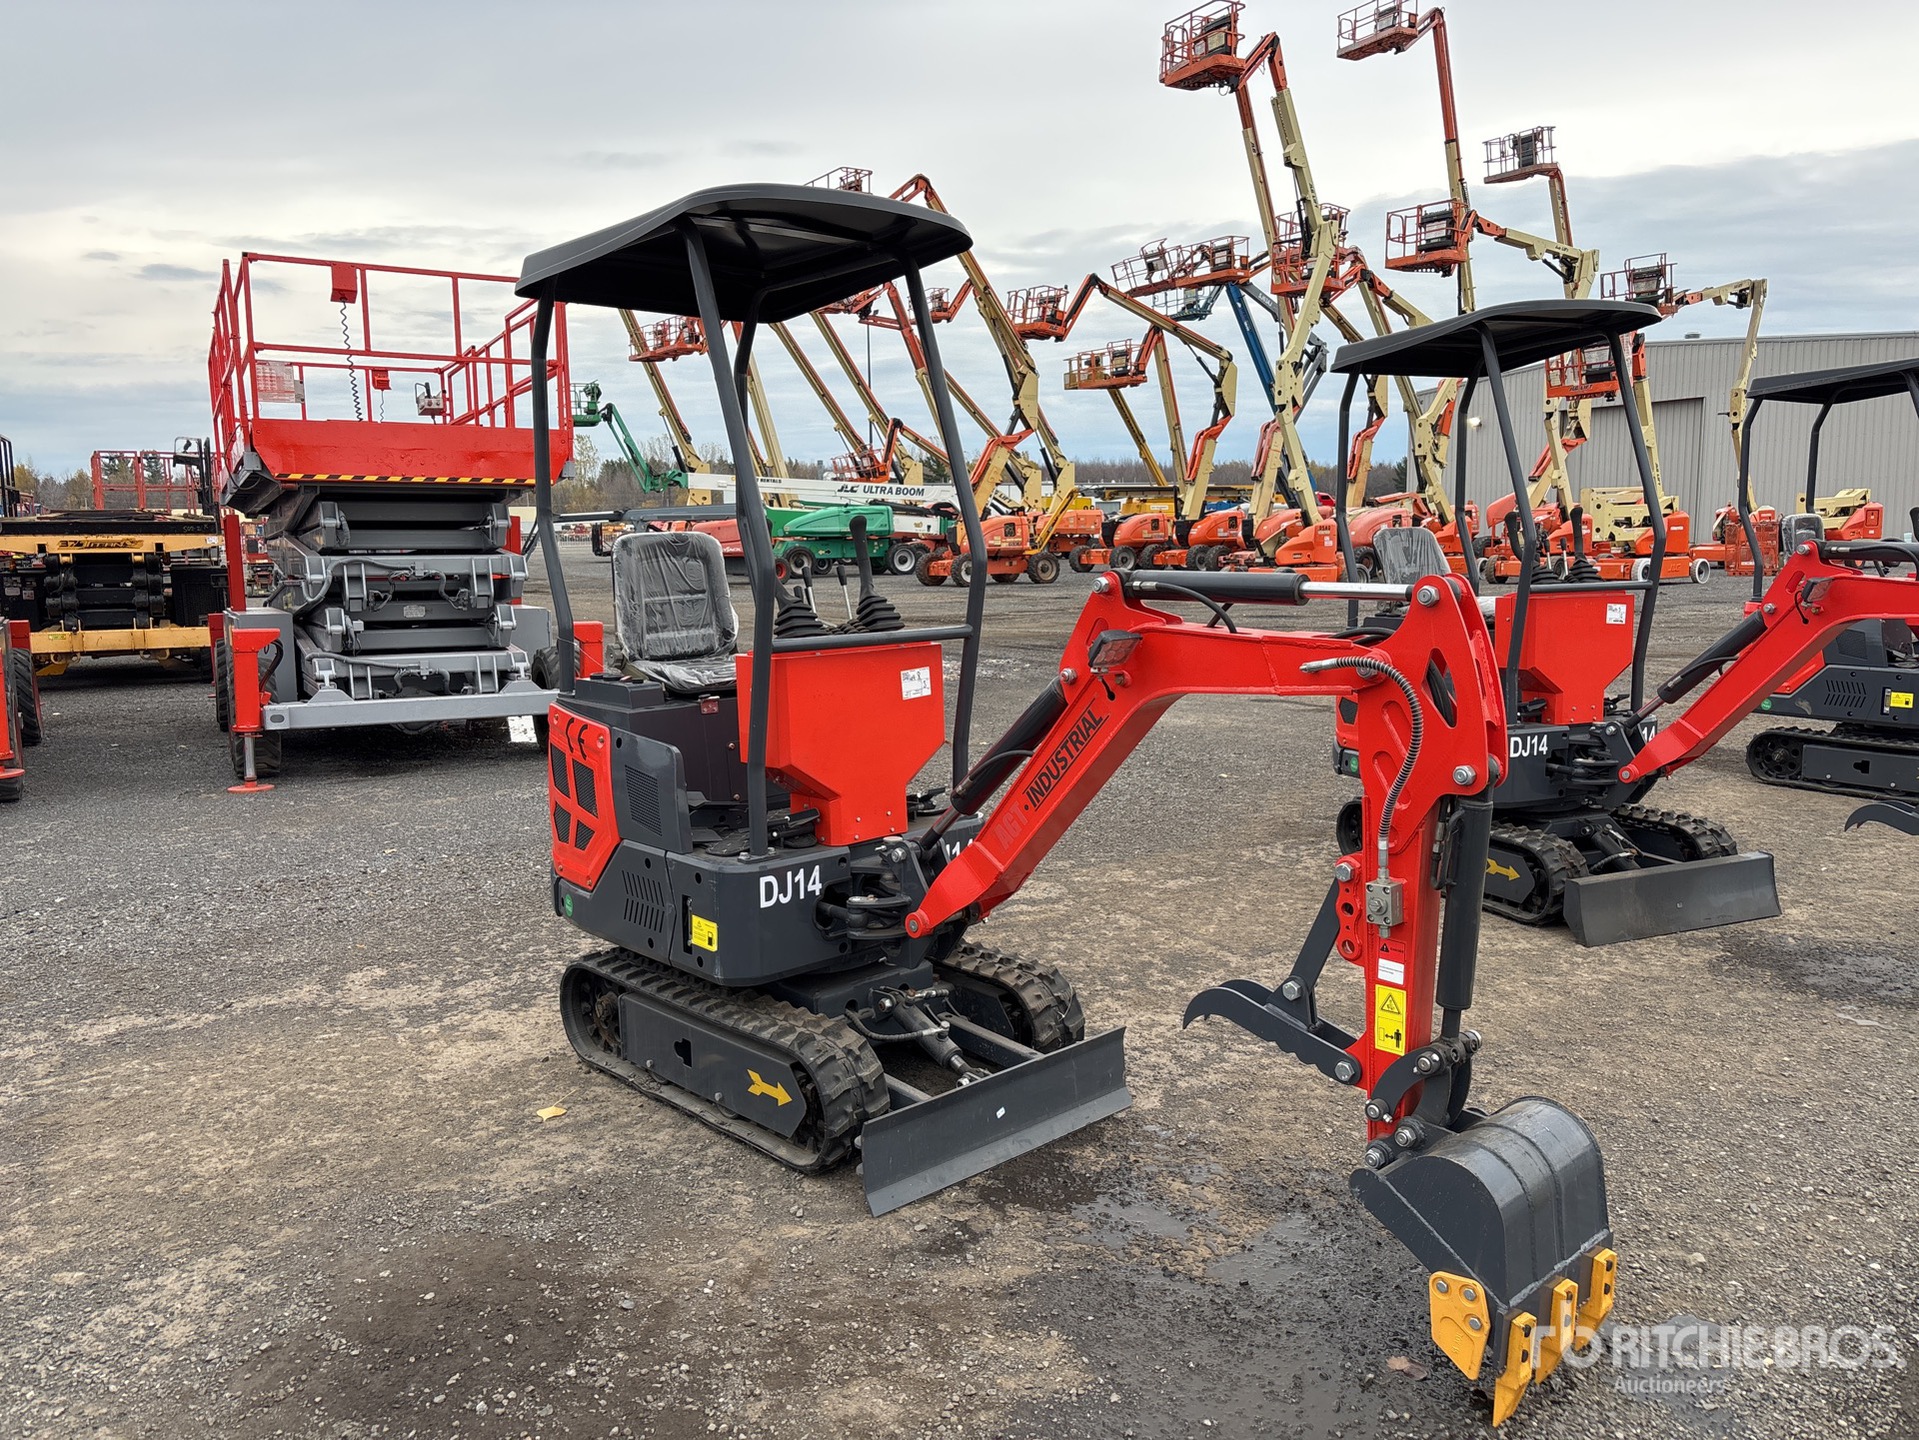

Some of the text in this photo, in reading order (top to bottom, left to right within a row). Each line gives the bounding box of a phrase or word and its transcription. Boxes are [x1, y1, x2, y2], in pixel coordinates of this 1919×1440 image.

[1025, 709, 1104, 808] INDUSTRIAL
[1509, 734, 1548, 758] DJ14
[759, 865, 823, 909] DJ14
